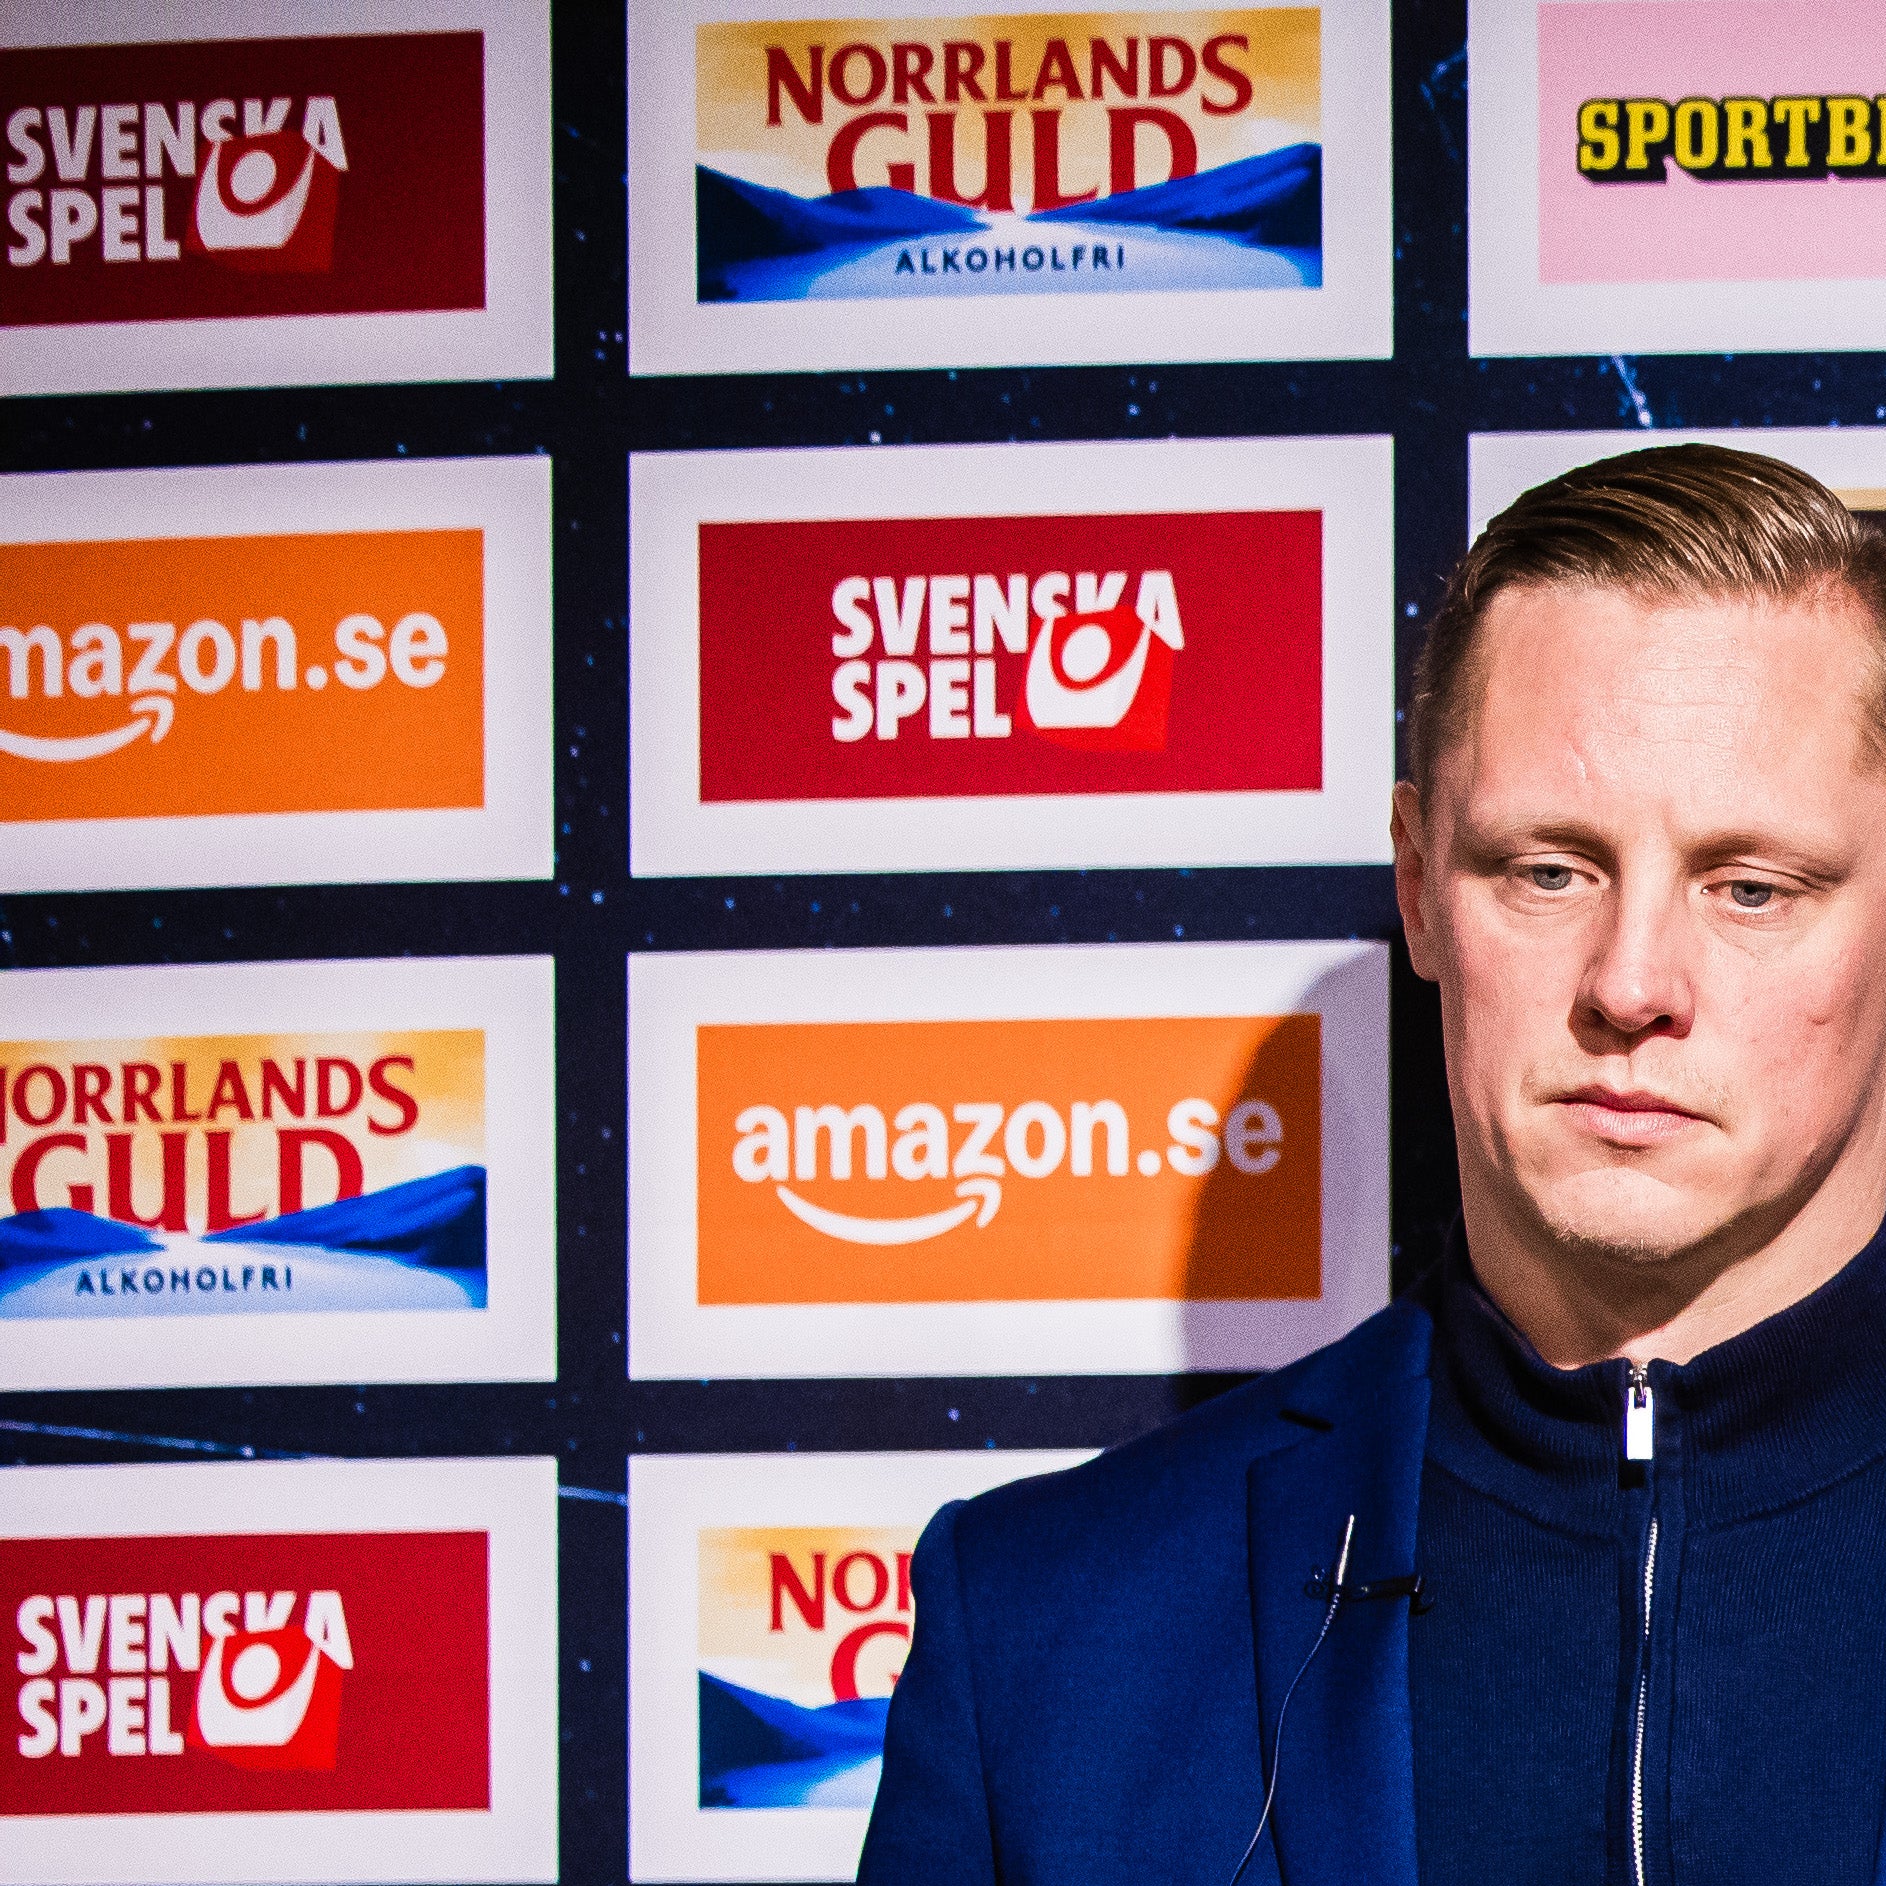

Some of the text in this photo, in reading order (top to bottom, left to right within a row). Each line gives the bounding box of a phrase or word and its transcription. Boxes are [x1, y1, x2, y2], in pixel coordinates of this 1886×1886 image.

[767, 33, 1253, 126] NORRLANDS
[7, 96, 350, 184] SVENSKA
[826, 110, 1198, 212] GULD
[8, 187, 180, 267] SPEL
[894, 245, 1127, 276] ALKOHOLFRI
[0, 613, 448, 697] mazon.se
[832, 570, 1185, 657] SVENSKA
[832, 659, 1012, 744] SPEL
[0, 1055, 419, 1144] ORRLANDS
[731, 1095, 1282, 1186] amazon.se
[9, 1127, 363, 1232] GULD
[74, 1264, 294, 1297] ALKOHOLFRI
[15, 1590, 354, 1676] SVENSKA
[17, 1676, 184, 1757] SPEL
